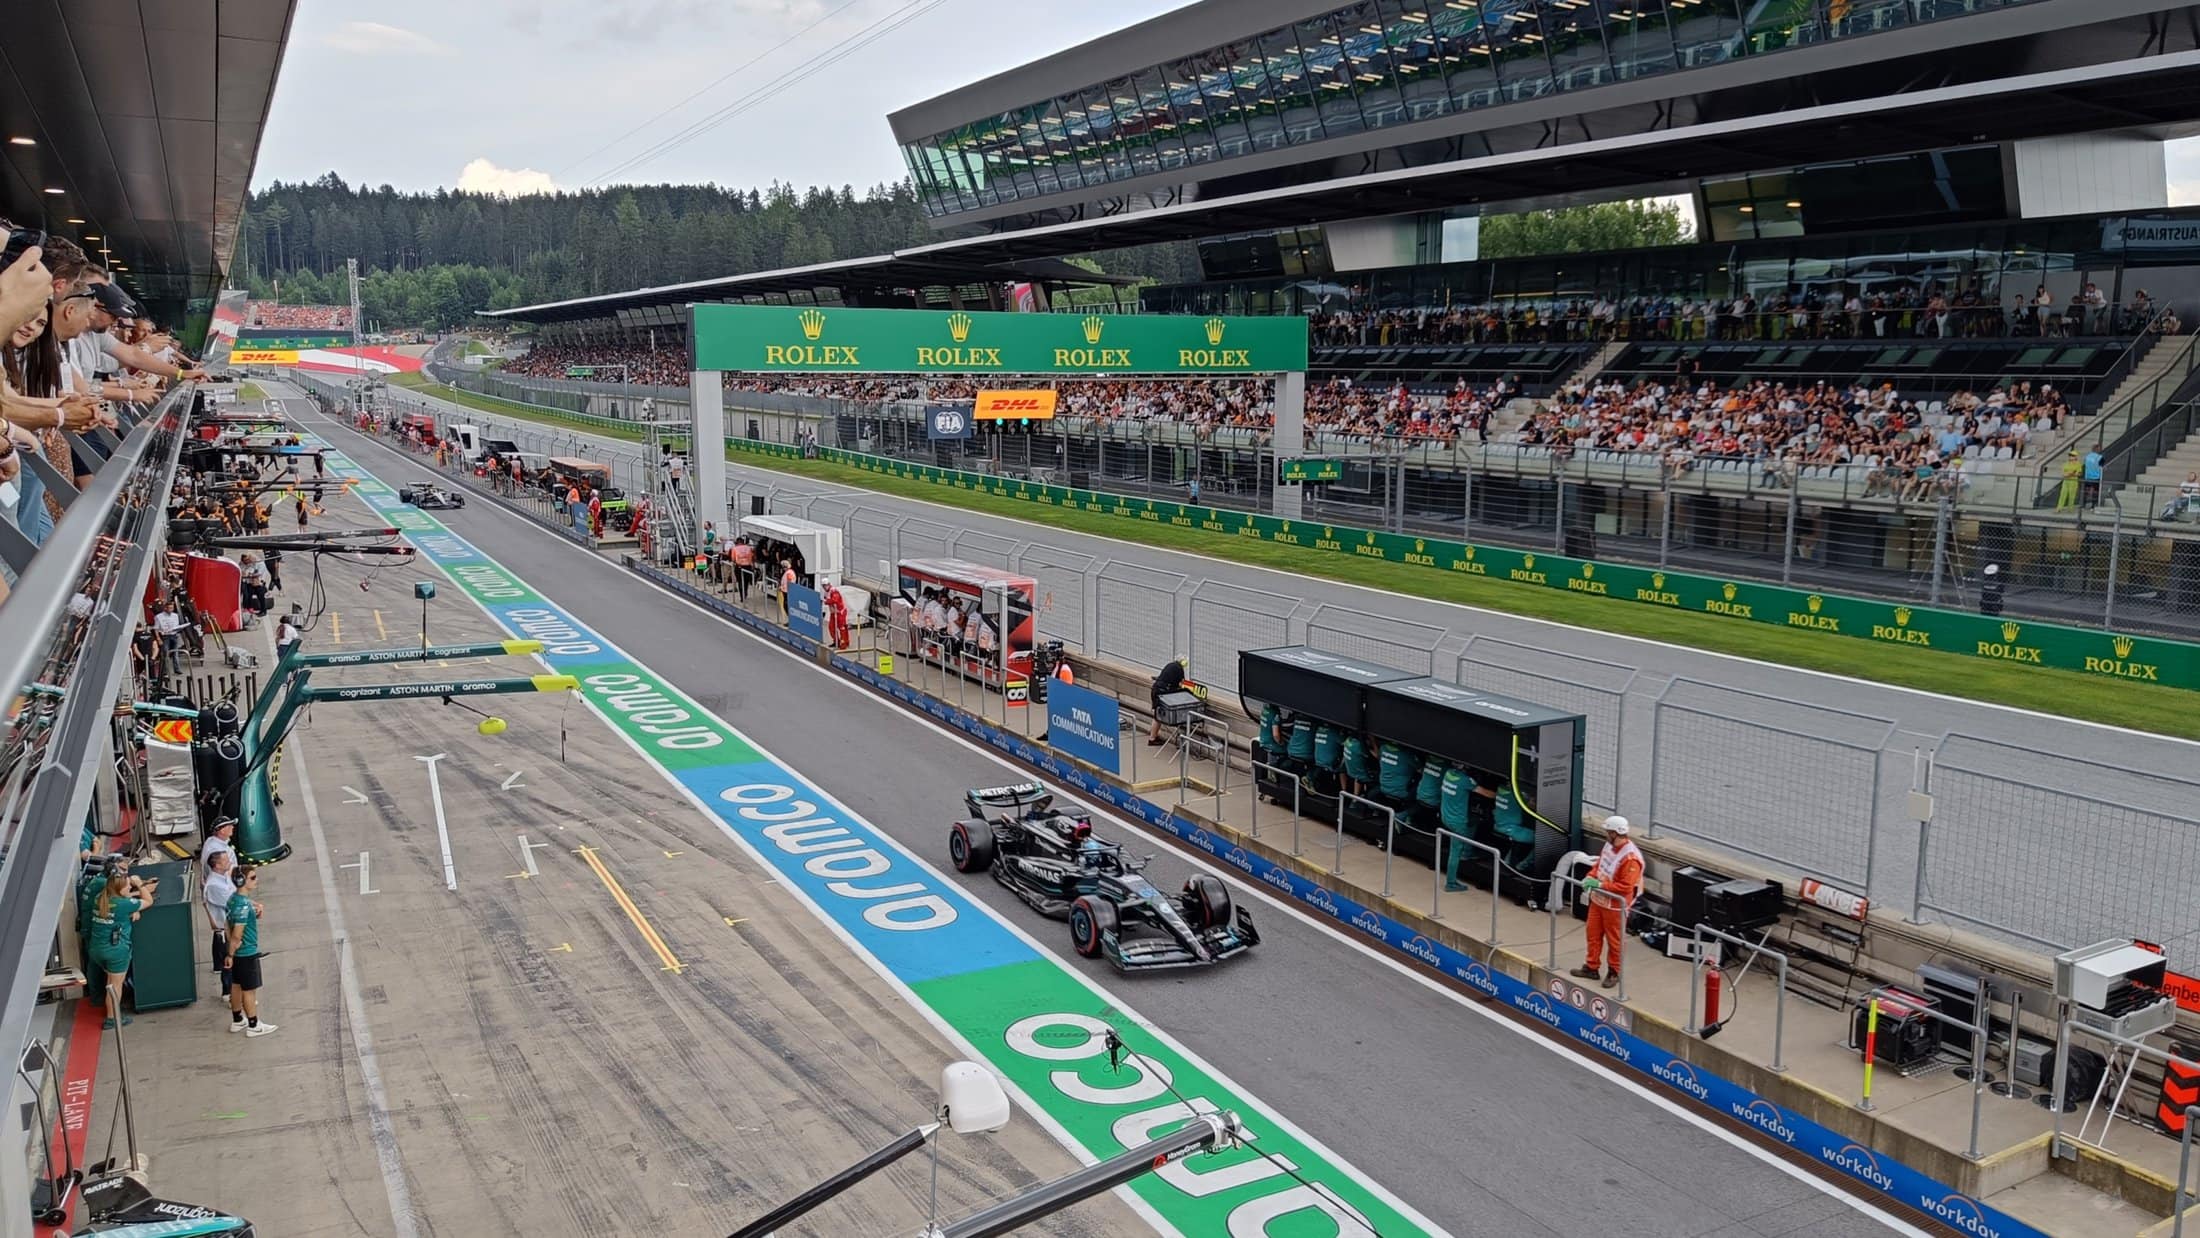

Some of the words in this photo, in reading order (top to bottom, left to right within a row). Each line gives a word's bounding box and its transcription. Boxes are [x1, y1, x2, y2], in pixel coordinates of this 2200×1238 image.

[241, 353, 278, 361] DHL
[765, 345, 859, 366] ROLEX
[917, 347, 1002, 367] ROLEX
[1054, 349, 1131, 367] ROLEX
[1178, 350, 1250, 367] ROLEX
[990, 399, 1040, 411] DHL
[935, 413, 963, 432] FIA
[1172, 516, 1191, 527] ROLEX
[1203, 520, 1223, 532] ROLEX
[1238, 527, 1261, 538] ROLEX
[1274, 532, 1298, 544] ROLEX
[1316, 539, 1341, 551] ROLEX
[1356, 544, 1385, 558] ROLEX
[1405, 552, 1434, 566] ROLEX
[1453, 560, 1486, 575] ROLEX
[1511, 568, 1547, 584] ROLEX
[1568, 578, 1606, 594] ROLEX
[1637, 588, 1680, 606] ROLEX
[1705, 599, 1752, 618] ROLEX
[505, 608, 601, 656] aramco
[1788, 612, 1840, 632] ROLEX
[1872, 625, 1930, 646] ROLEX
[328, 655, 361, 663] aramco
[369, 652, 395, 661] ASTON
[1977, 641, 2041, 663] ROLEX
[2085, 656, 2158, 681] ROLEX
[340, 687, 382, 698] cognizant
[389, 686, 418, 695] ASTON
[420, 684, 454, 694] MARTIN
[462, 682, 496, 691] aramco
[584, 674, 724, 750] aramco
[1071, 707, 1092, 726] TATA
[1051, 713, 1115, 751] COMMUNICATIONS
[1093, 787, 1116, 805] workday
[1122, 802, 1146, 820] workday
[1154, 818, 1179, 836] workday
[1188, 832, 1214, 854] workday
[718, 783, 958, 931] aramco
[1224, 851, 1253, 873] workday
[1263, 870, 1293, 894] workday
[1305, 892, 1338, 917] workday
[1804, 880, 1862, 917] LANCE
[1351, 914, 1387, 941] workday
[1401, 939, 1440, 967] workday
[1456, 965, 1498, 997] workday
[1514, 993, 1560, 1027] workday
[1579, 1026, 1630, 1062] workday
[1652, 1062, 1708, 1100] workday
[1732, 1101, 1795, 1142] workday
[1822, 1146, 1892, 1191] workday
[154, 1202, 216, 1222] cognizant
